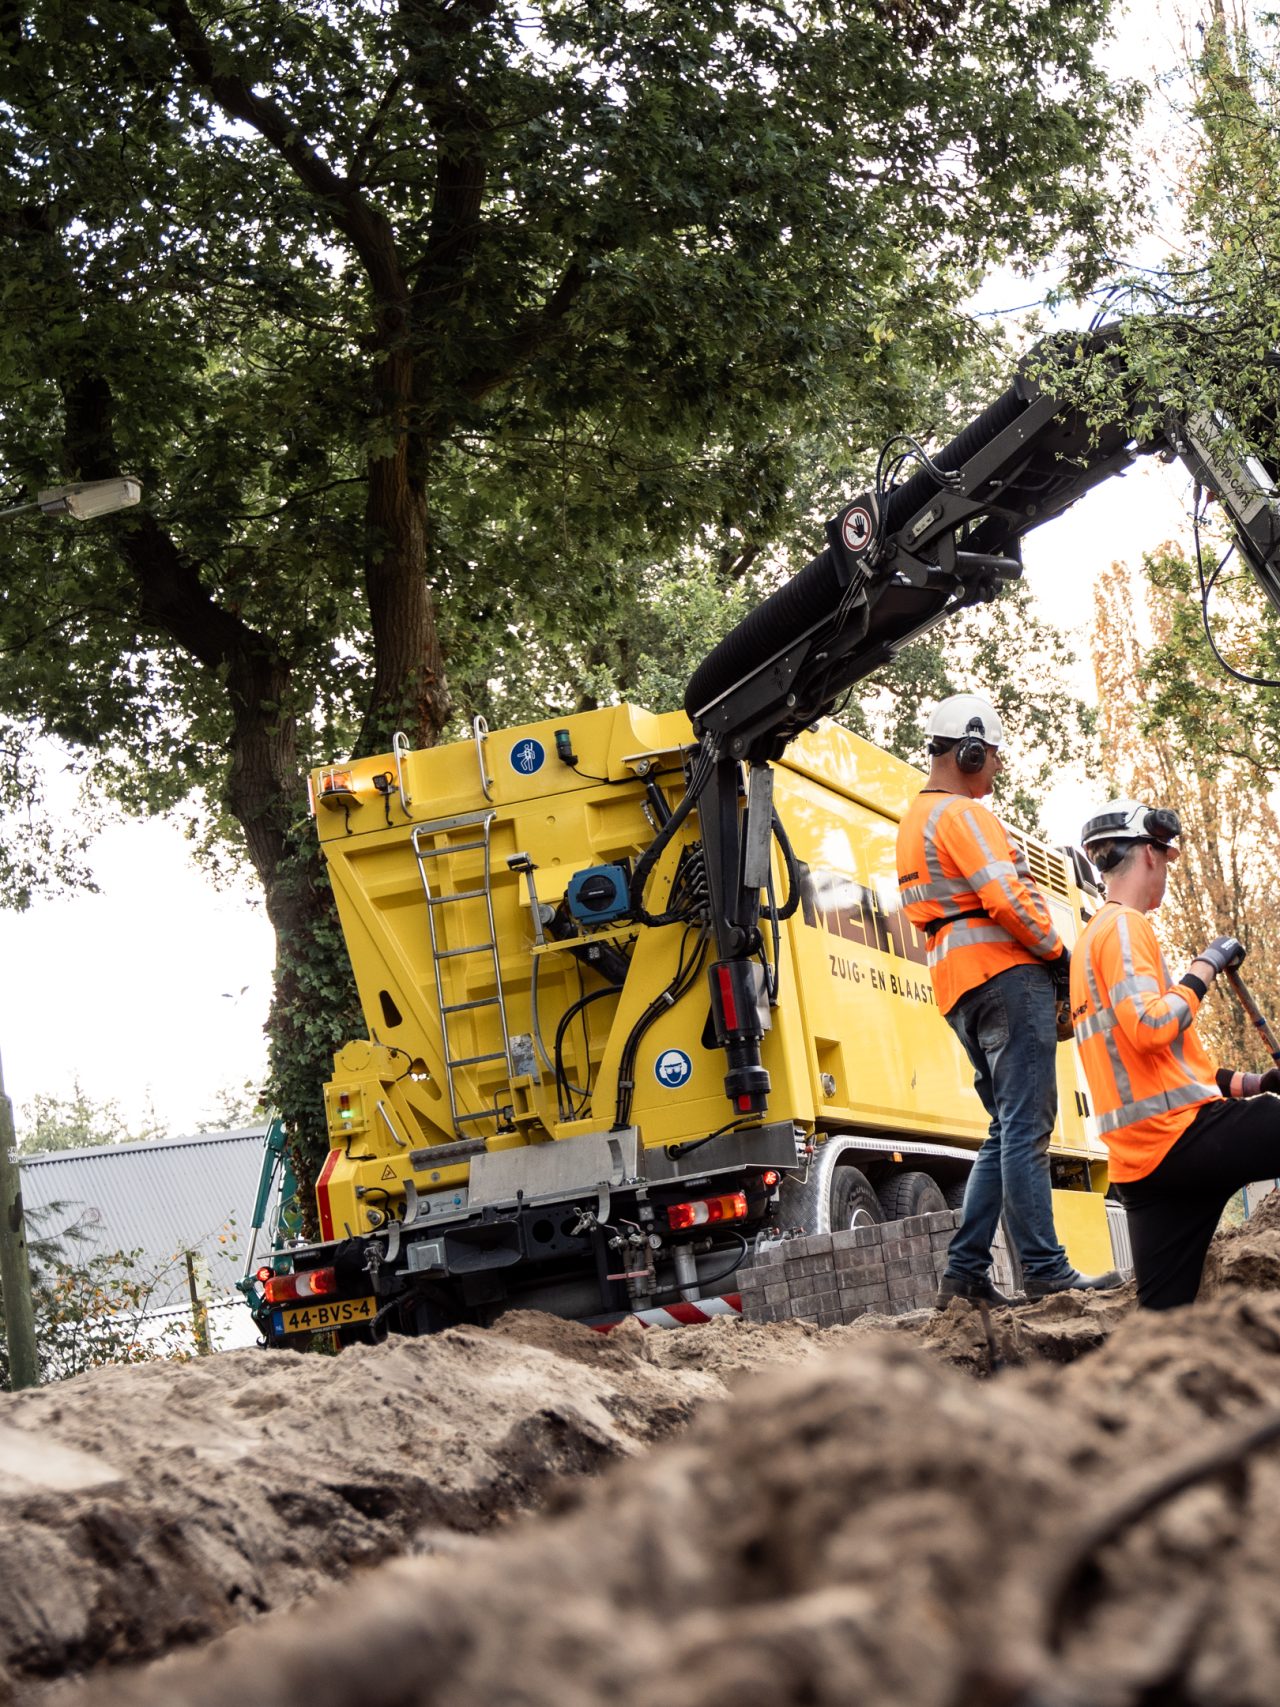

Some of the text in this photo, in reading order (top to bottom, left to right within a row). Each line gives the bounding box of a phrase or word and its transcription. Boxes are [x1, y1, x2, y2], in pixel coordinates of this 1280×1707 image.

[829, 954, 939, 1006] ZUIG- EN BLAAST
[289, 1300, 370, 1328] 44-BVS-4
